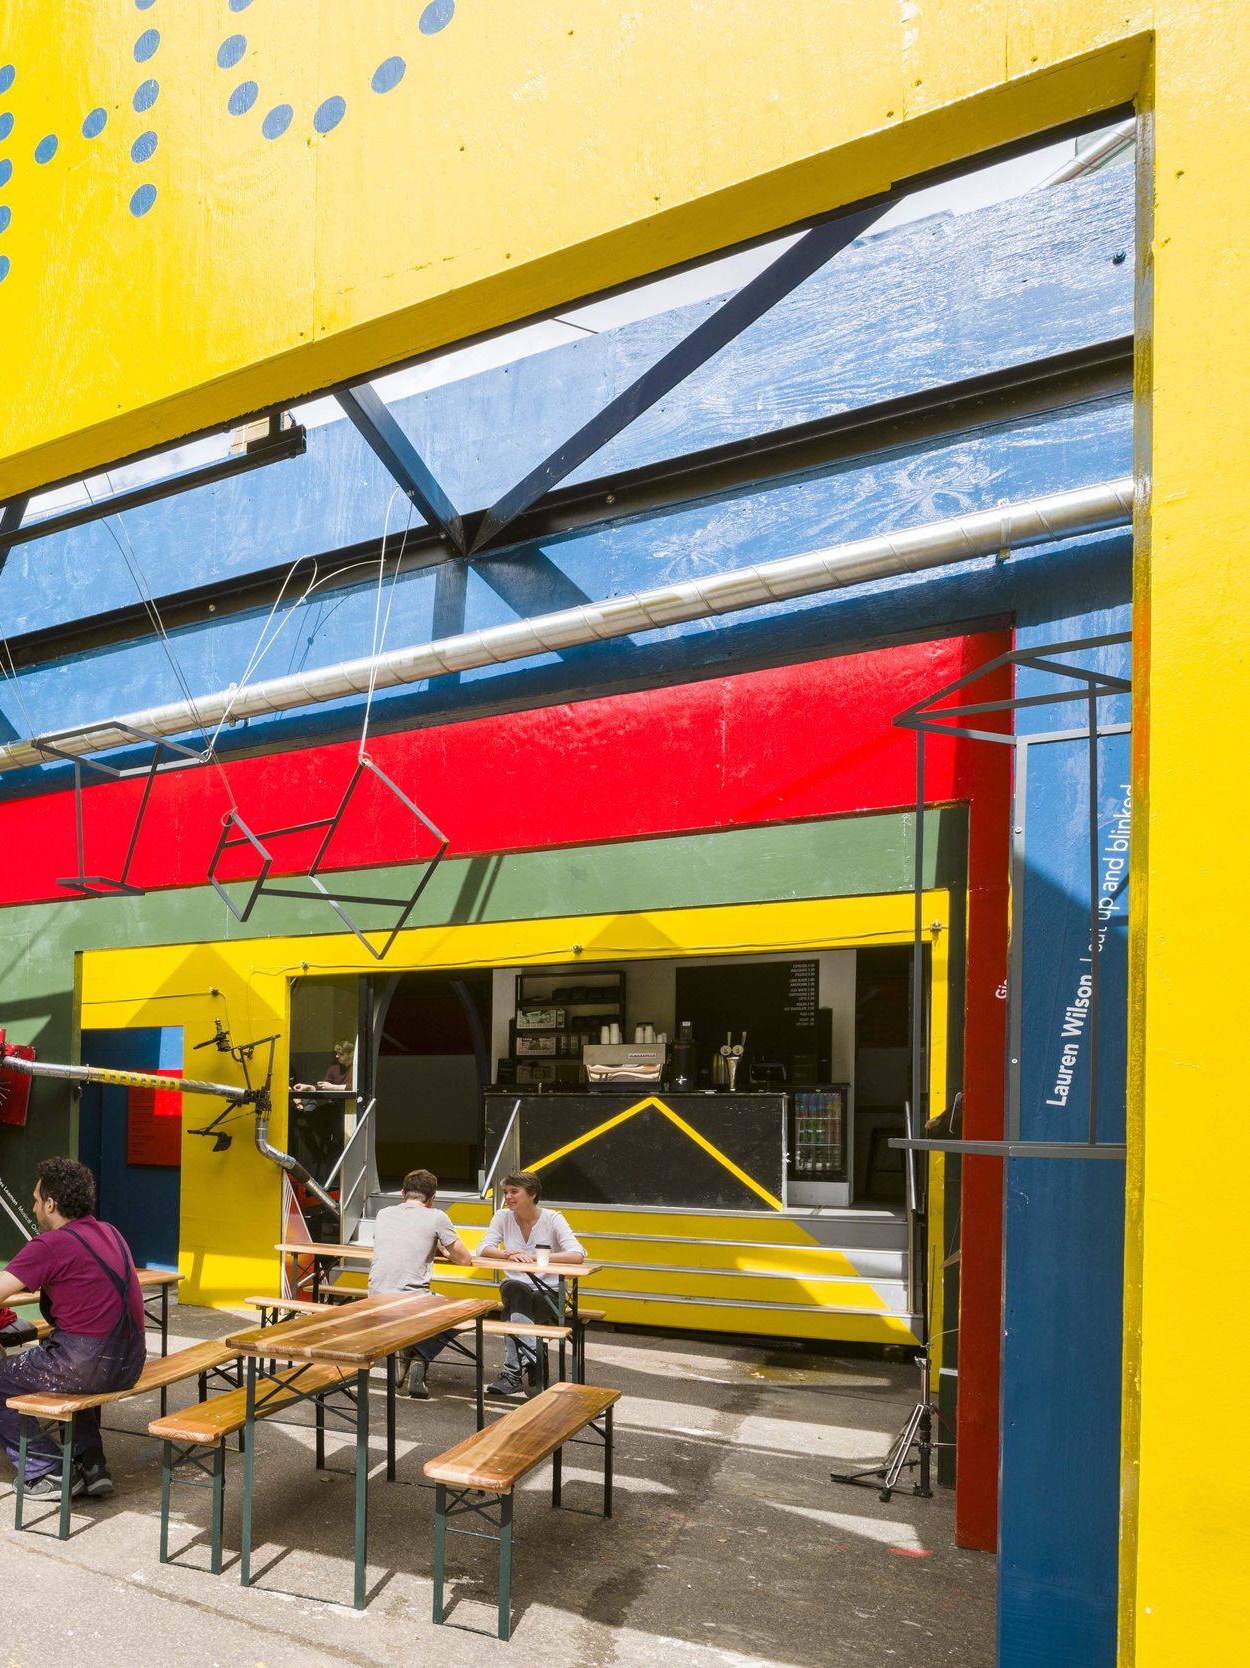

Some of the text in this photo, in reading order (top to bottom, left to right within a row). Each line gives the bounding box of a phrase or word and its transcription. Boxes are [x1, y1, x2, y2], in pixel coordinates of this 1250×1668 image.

[1102, 857, 1125, 892] and
[1098, 897, 1120, 921] up
[1061, 973, 1093, 1038] Wilson
[1046, 1043, 1080, 1107] Lauren
